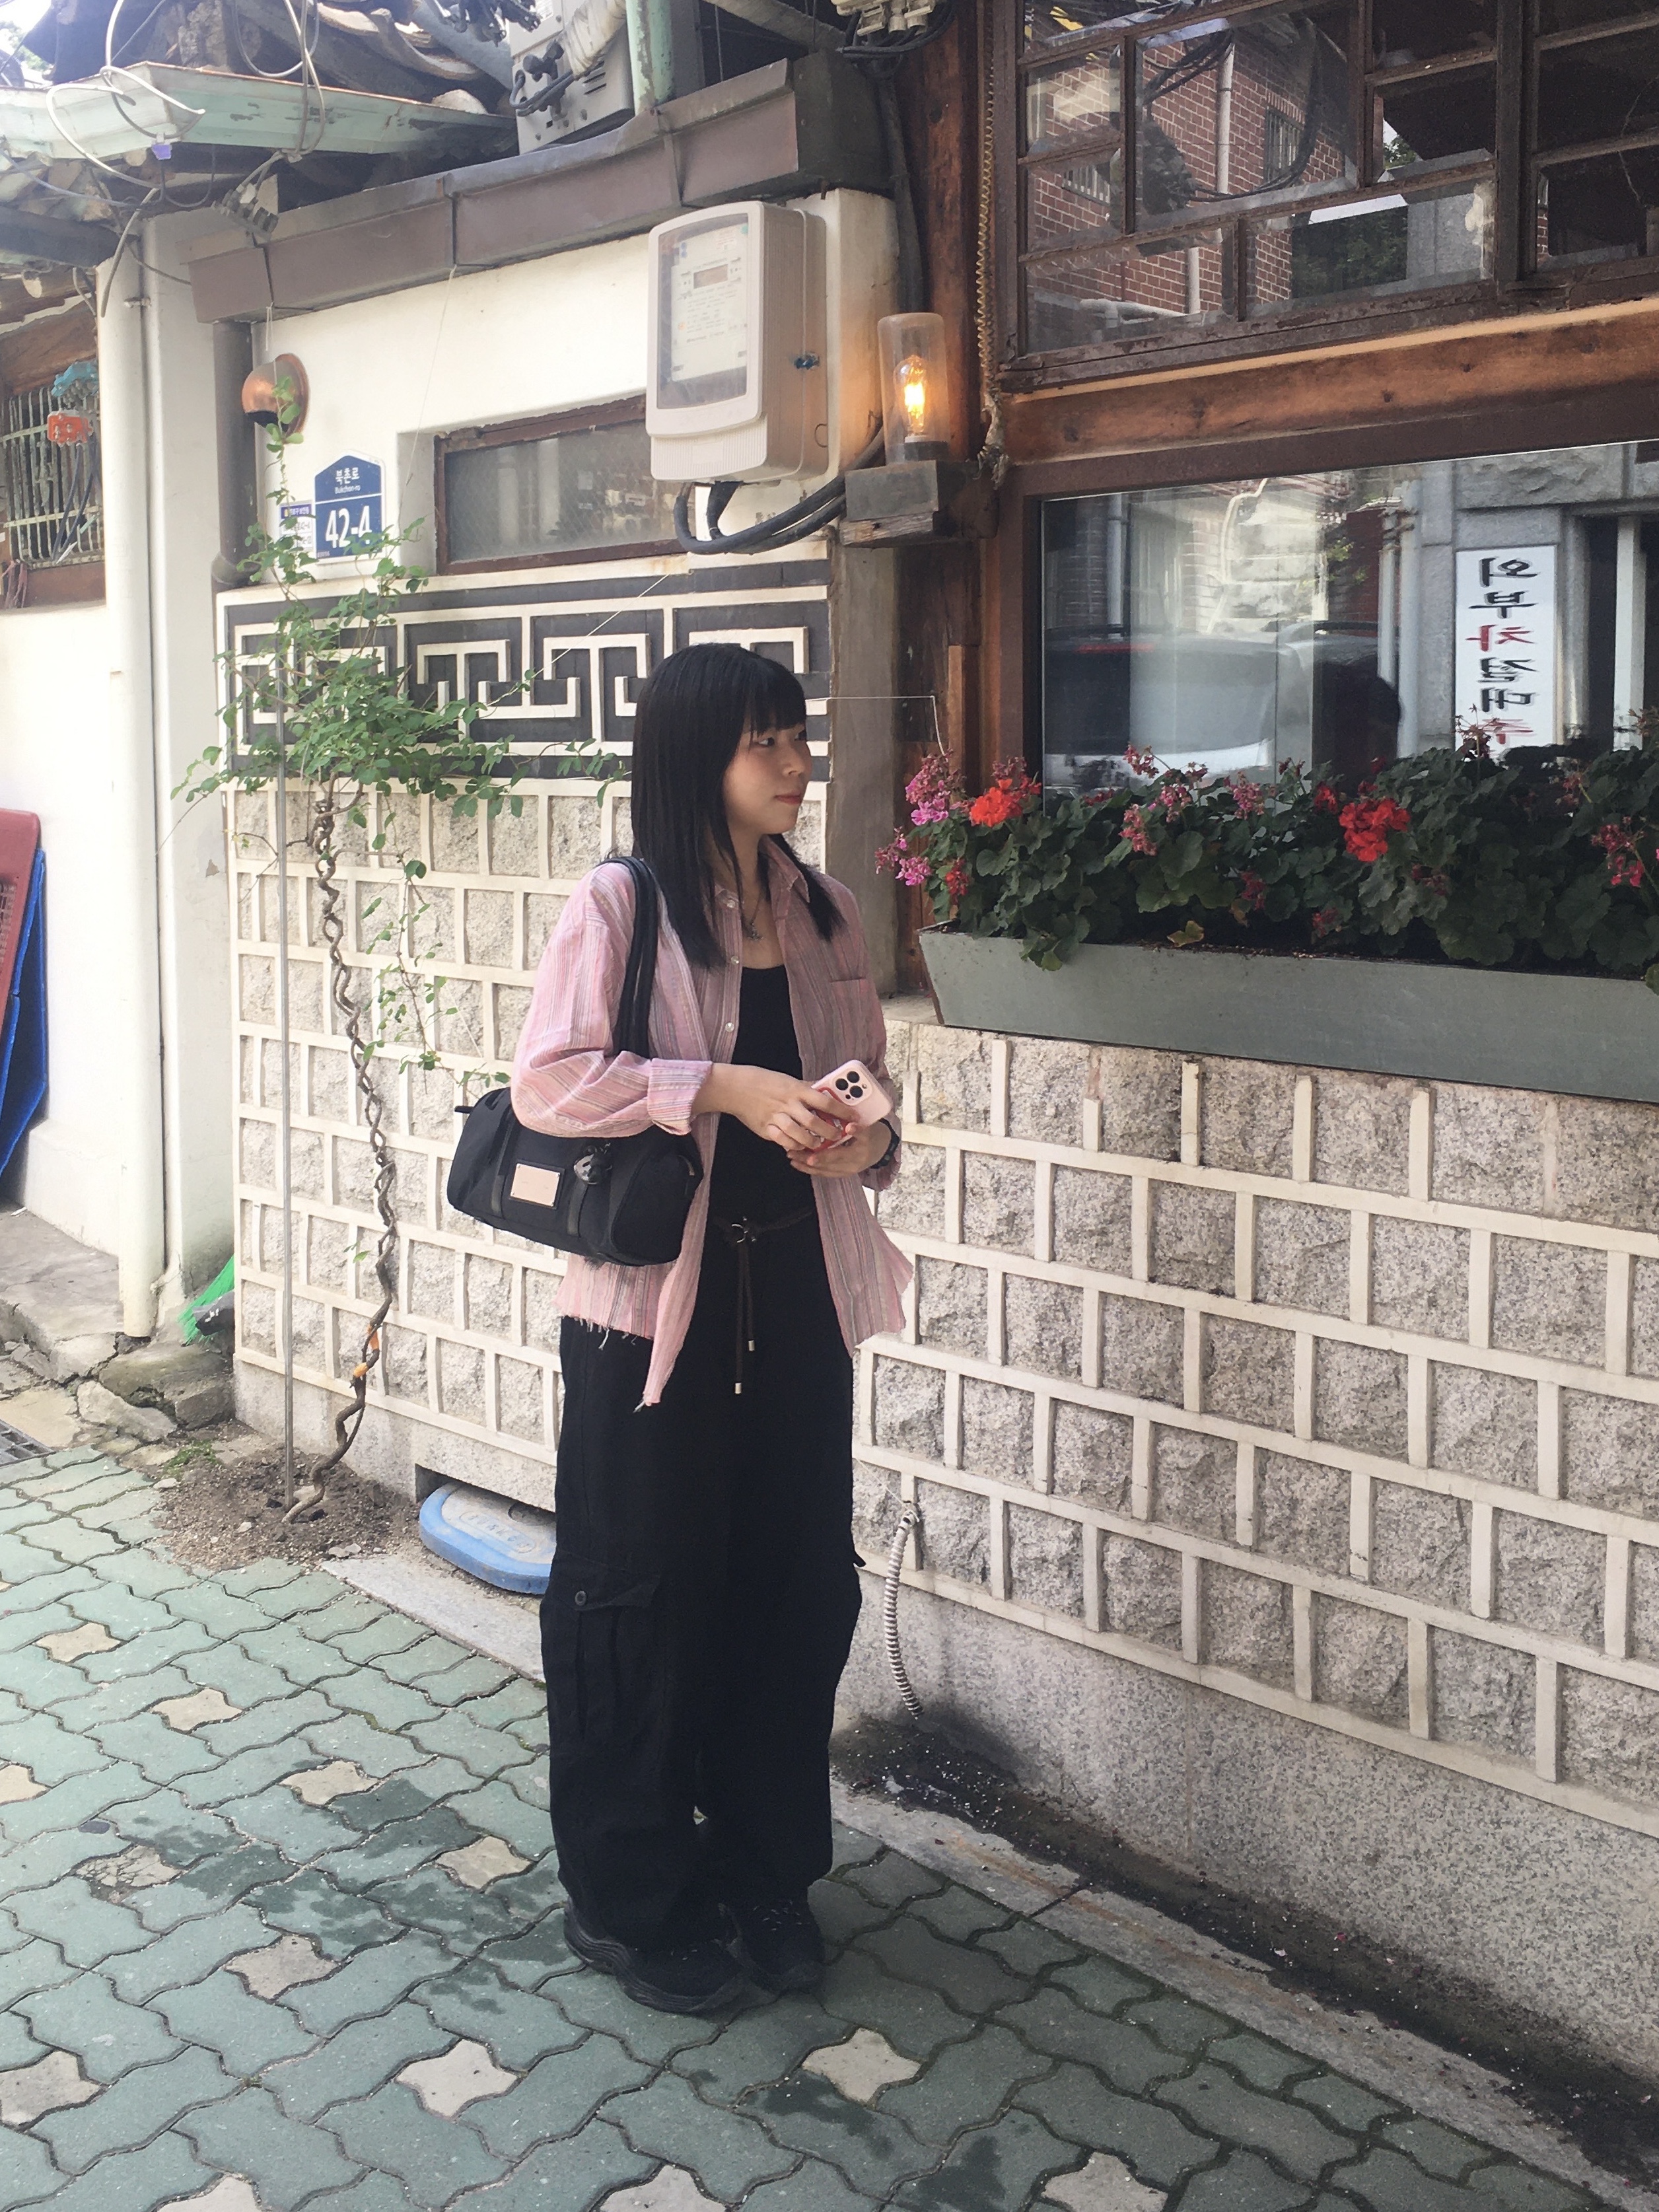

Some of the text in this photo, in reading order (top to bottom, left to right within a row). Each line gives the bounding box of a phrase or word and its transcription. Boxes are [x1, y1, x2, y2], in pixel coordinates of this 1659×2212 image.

[335, 467, 360, 485] 북촌로
[334, 485, 361, 494] Bukchon-ro
[325, 505, 372, 549] 42-4
